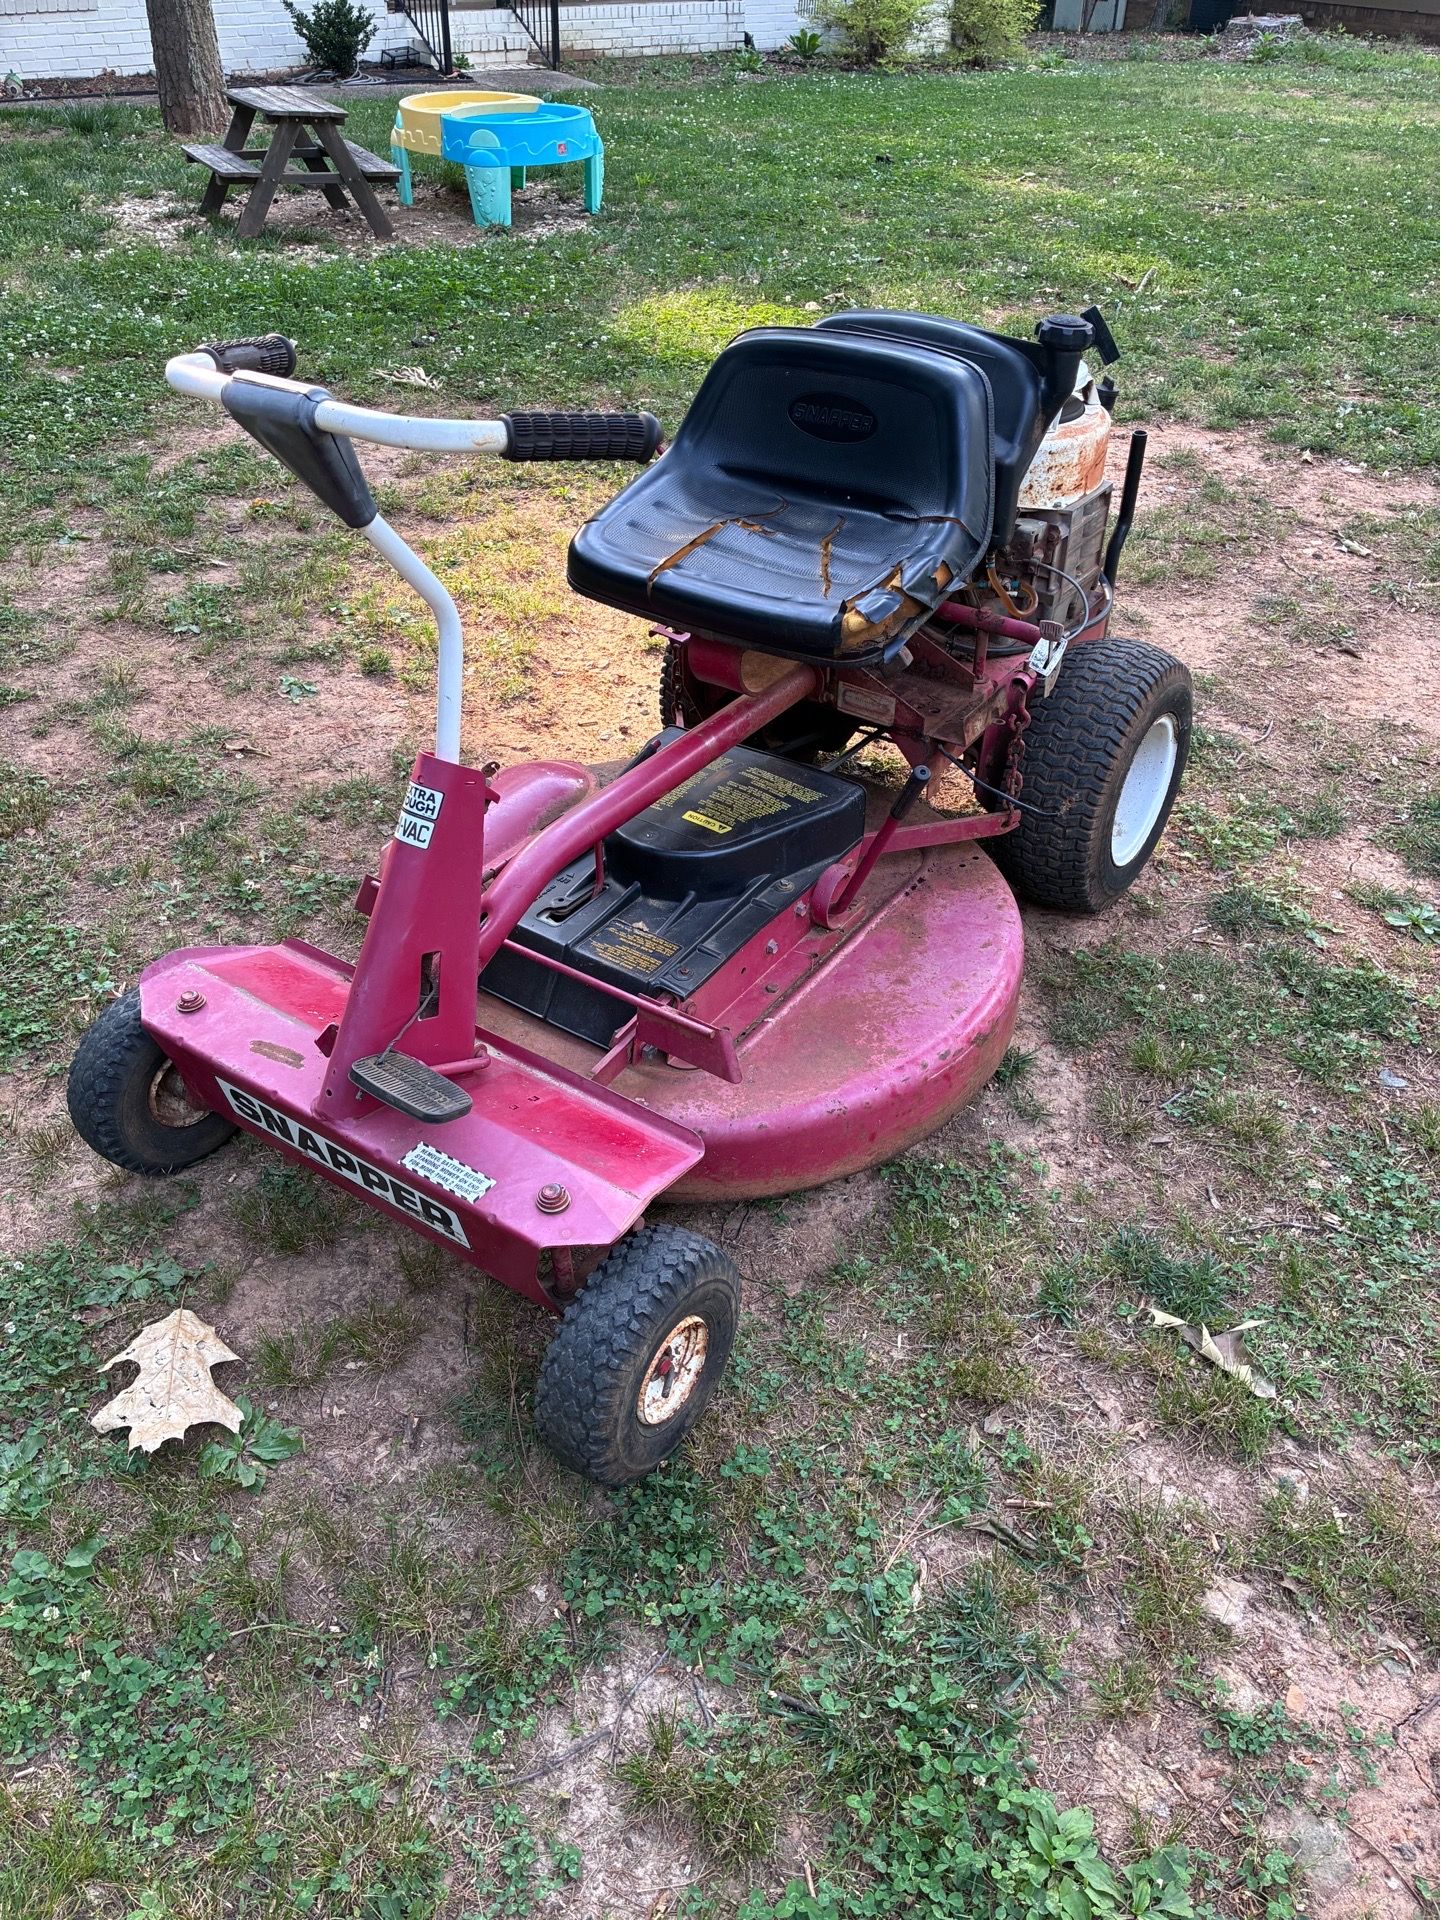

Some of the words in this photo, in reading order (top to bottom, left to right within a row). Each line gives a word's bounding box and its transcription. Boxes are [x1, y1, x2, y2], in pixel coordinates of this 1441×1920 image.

[795, 403, 873, 432] SNAPPER
[688, 813, 717, 828] CAUTION
[229, 1088, 456, 1237] SNAPPER
[408, 1159, 420, 1167] FOR
[419, 1164, 435, 1175] MORE
[435, 1173, 449, 1183] THAN
[453, 1183, 473, 1196] HOURS
[414, 1153, 441, 1170] STANDING
[439, 1167, 460, 1181] MOWER
[467, 1182, 480, 1191] END
[420, 1148, 442, 1162] REMOVE
[440, 1160, 464, 1174] BATTERY
[463, 1172, 485, 1185] BEFORE
